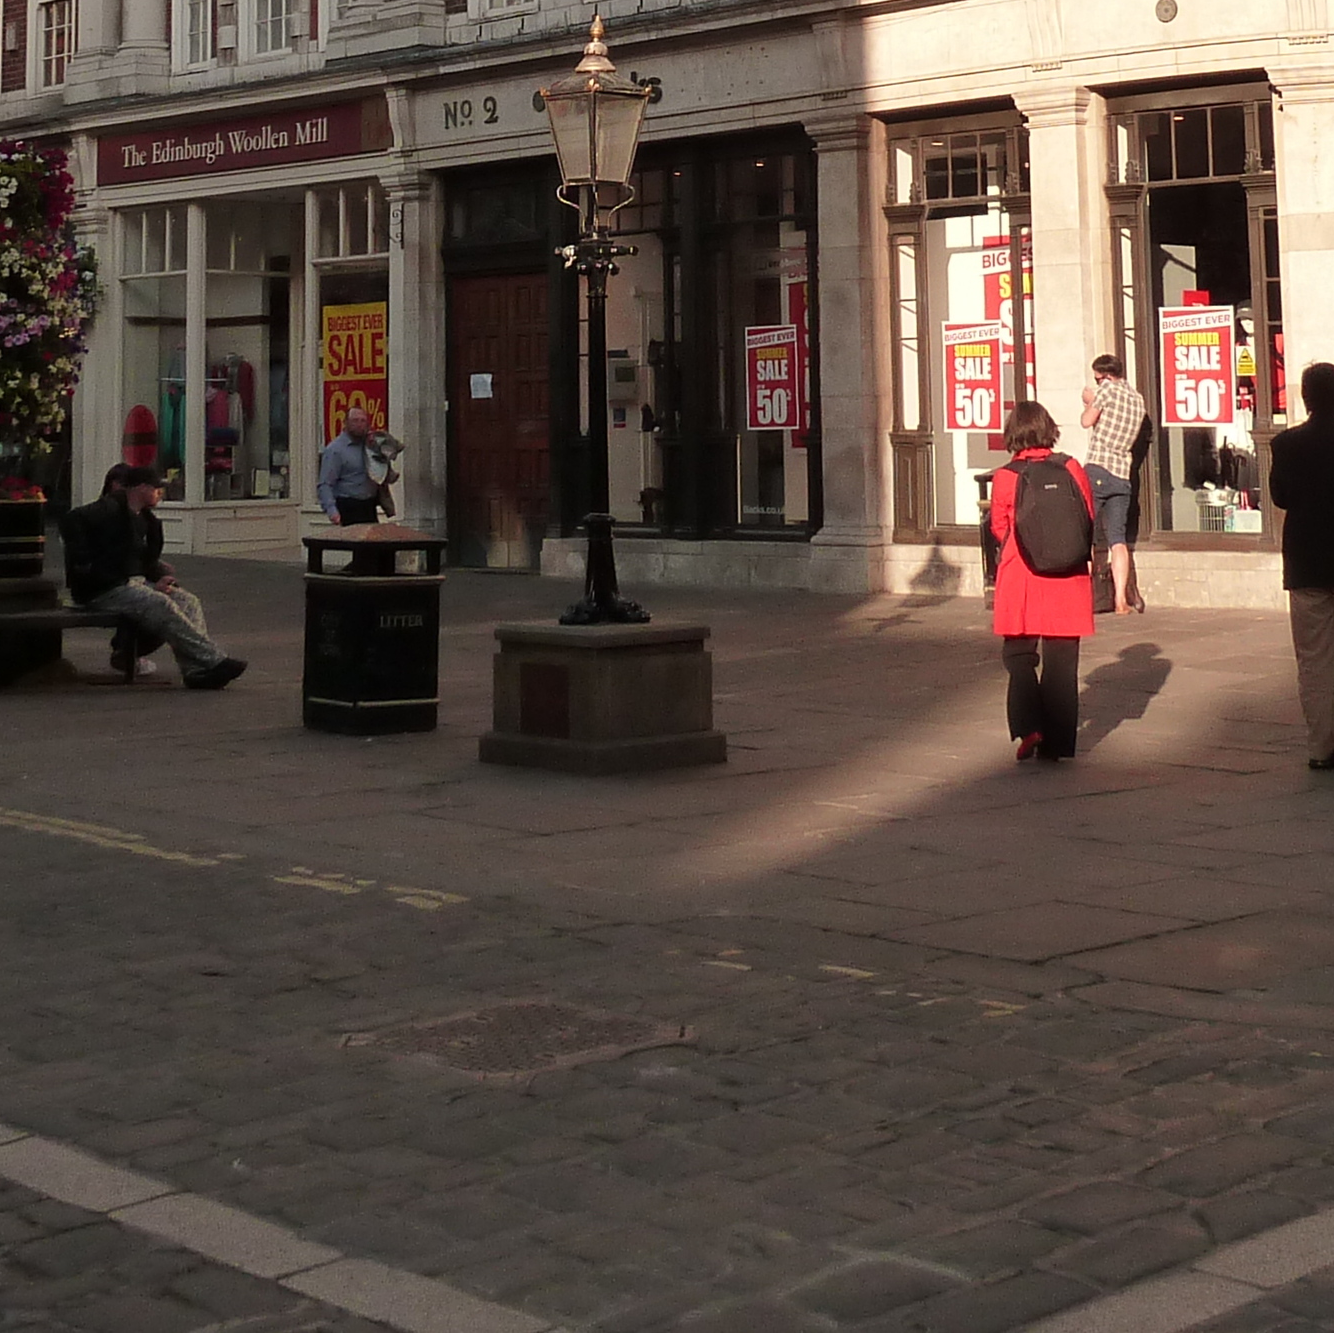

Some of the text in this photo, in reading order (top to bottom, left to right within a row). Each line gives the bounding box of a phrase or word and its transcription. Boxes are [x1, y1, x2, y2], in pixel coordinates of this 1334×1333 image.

[483, 96, 499, 124] 2
[121, 116, 328, 169] The Edinburgh Woollen Mill
[327, 313, 384, 332] BIGGEST EVER
[1162, 314, 1231, 330] BIGGEST EVER
[747, 331, 795, 346] BIGGEST EVER
[945, 327, 1000, 342] BIGGEST EVER
[1174, 332, 1220, 346] SUMMER
[328, 332, 385, 376] SALE
[1174, 346, 1221, 371] SALE
[756, 359, 788, 382] SALE
[954, 357, 992, 381] SALE
[379, 614, 424, 628] LITTER
